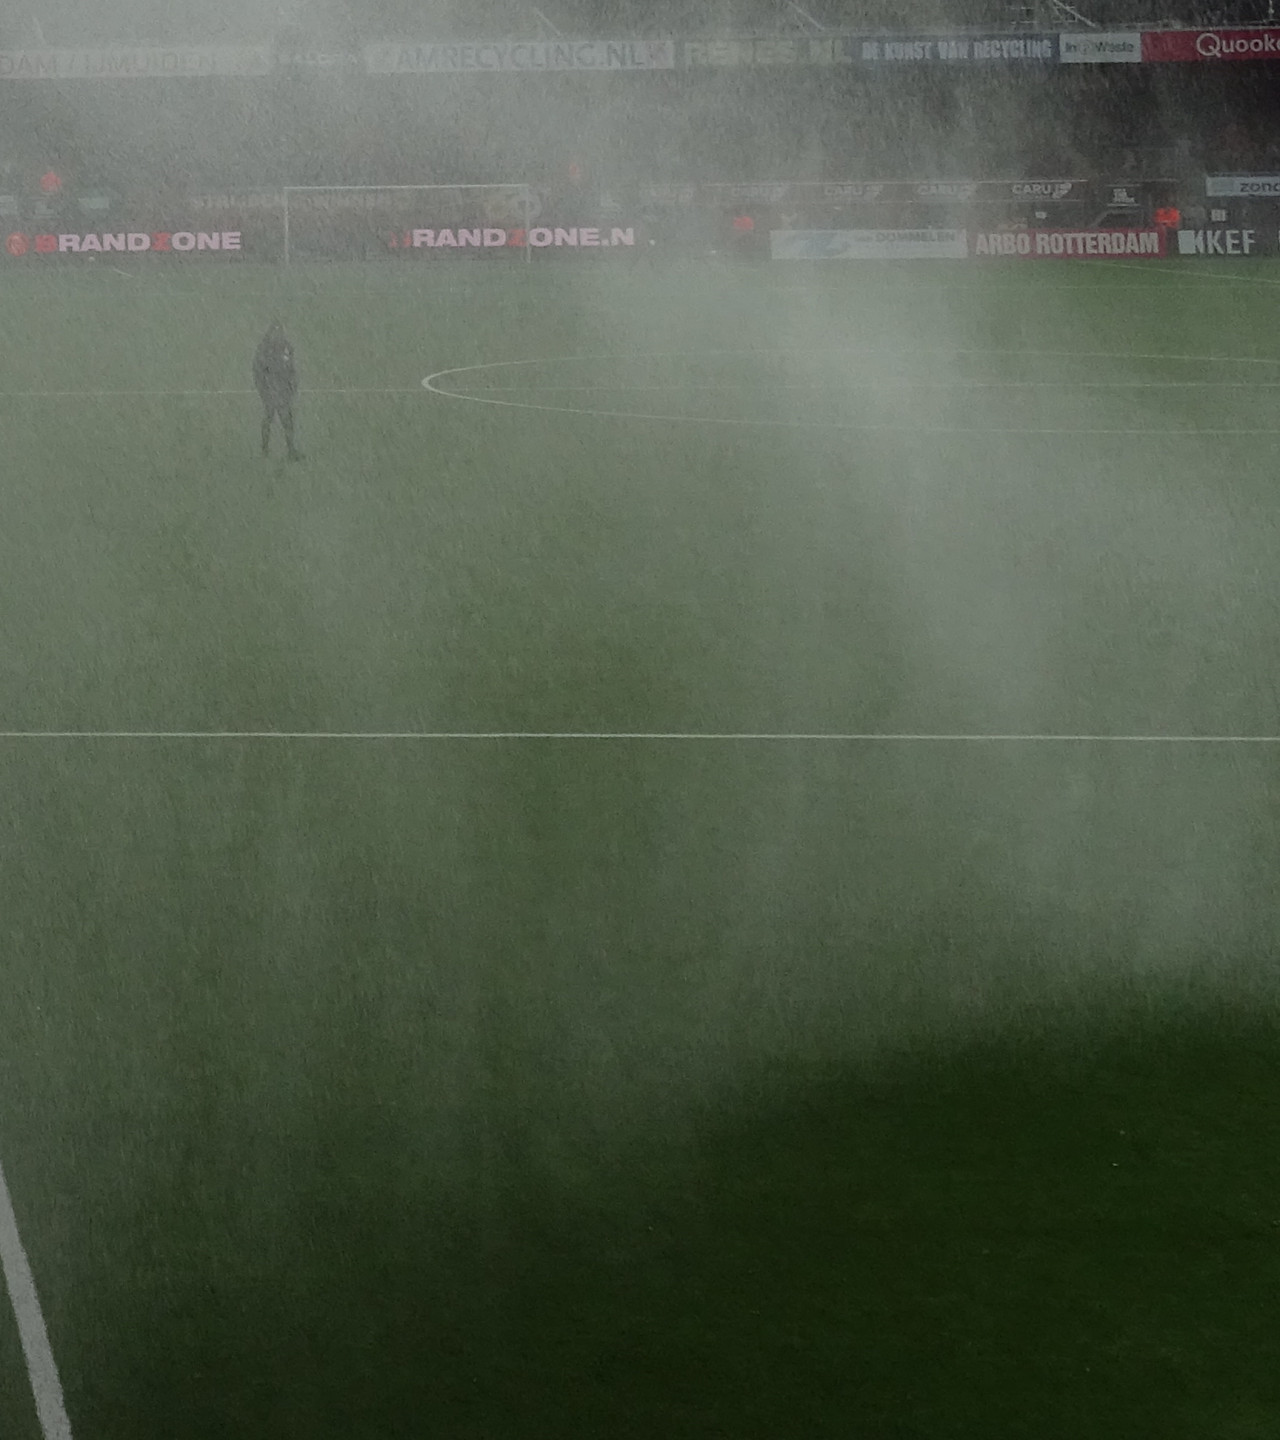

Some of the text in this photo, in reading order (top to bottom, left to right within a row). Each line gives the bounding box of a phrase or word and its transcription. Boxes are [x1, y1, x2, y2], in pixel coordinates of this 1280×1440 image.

[974, 39, 1052, 59] RECYCLING
[1196, 32, 1280, 57] Quook
[975, 230, 1159, 256] ARBO ROTTERDAM
